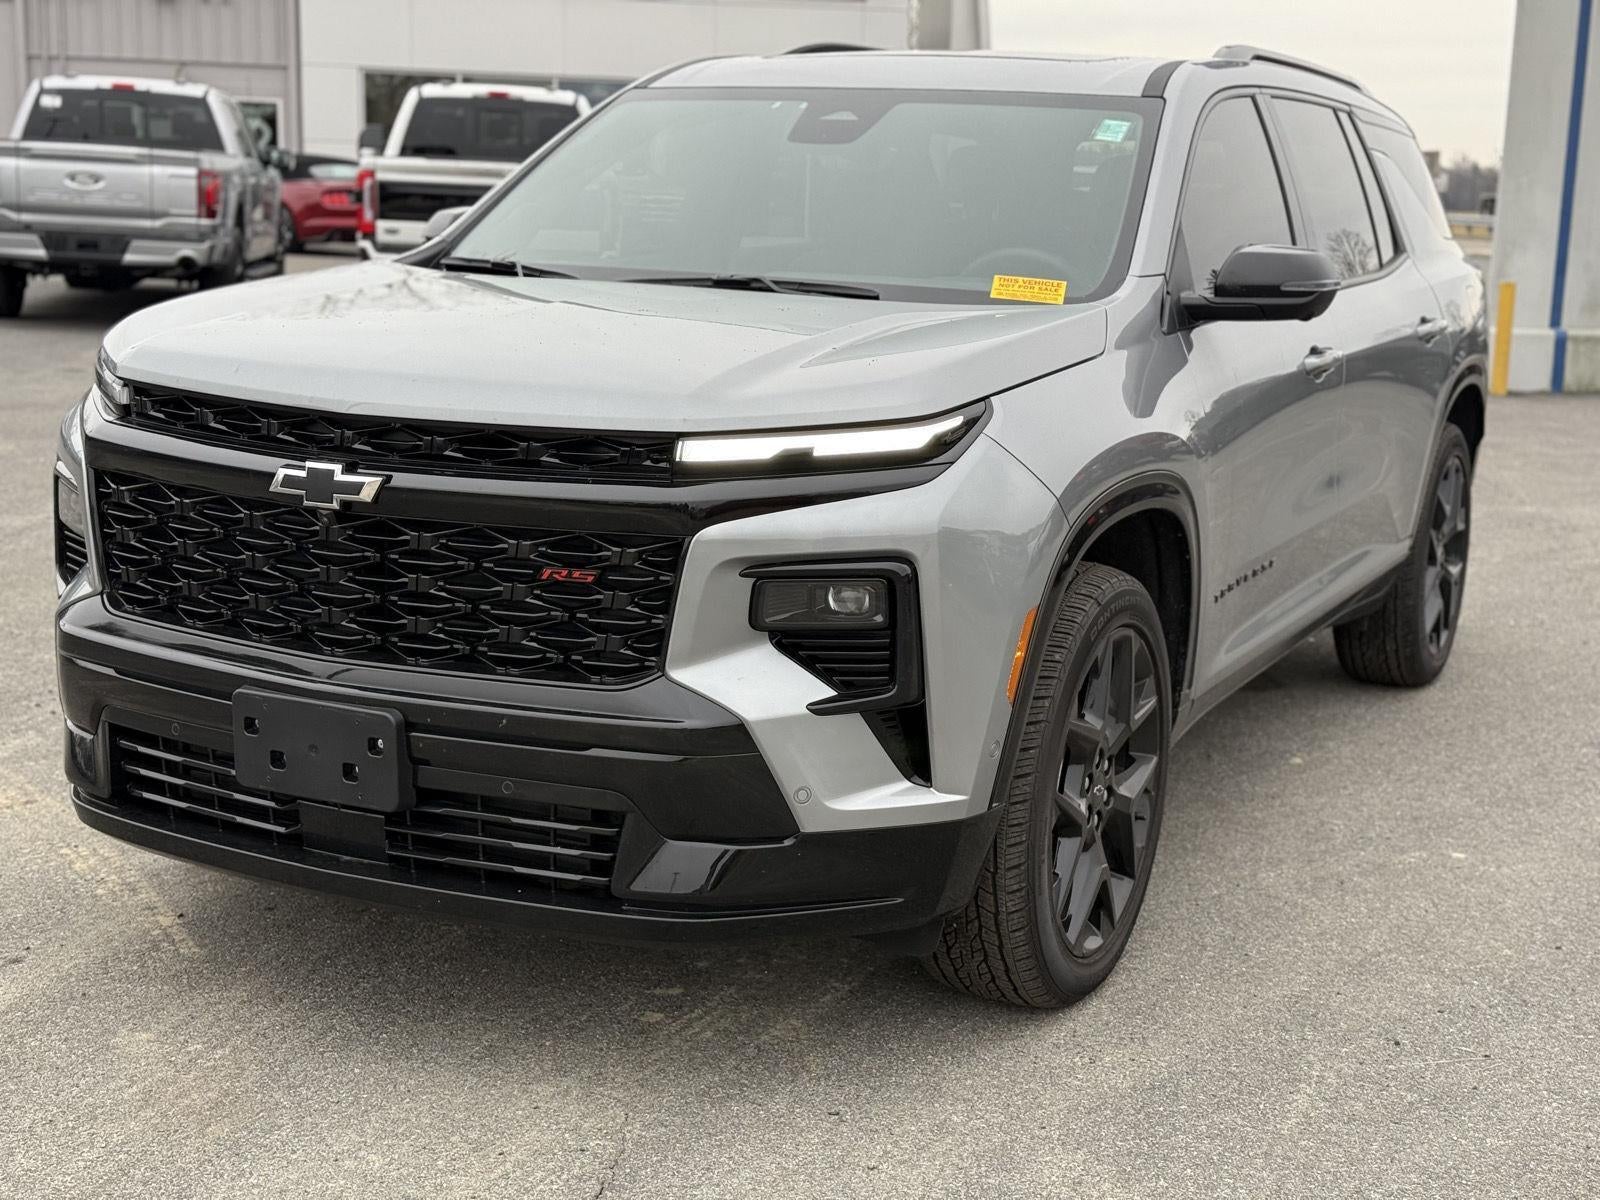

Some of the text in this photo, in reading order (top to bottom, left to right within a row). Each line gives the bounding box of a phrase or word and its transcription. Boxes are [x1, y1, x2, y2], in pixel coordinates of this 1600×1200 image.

[998, 277, 1063, 289] THIS VEHICLE
[539, 567, 598, 583] RS
